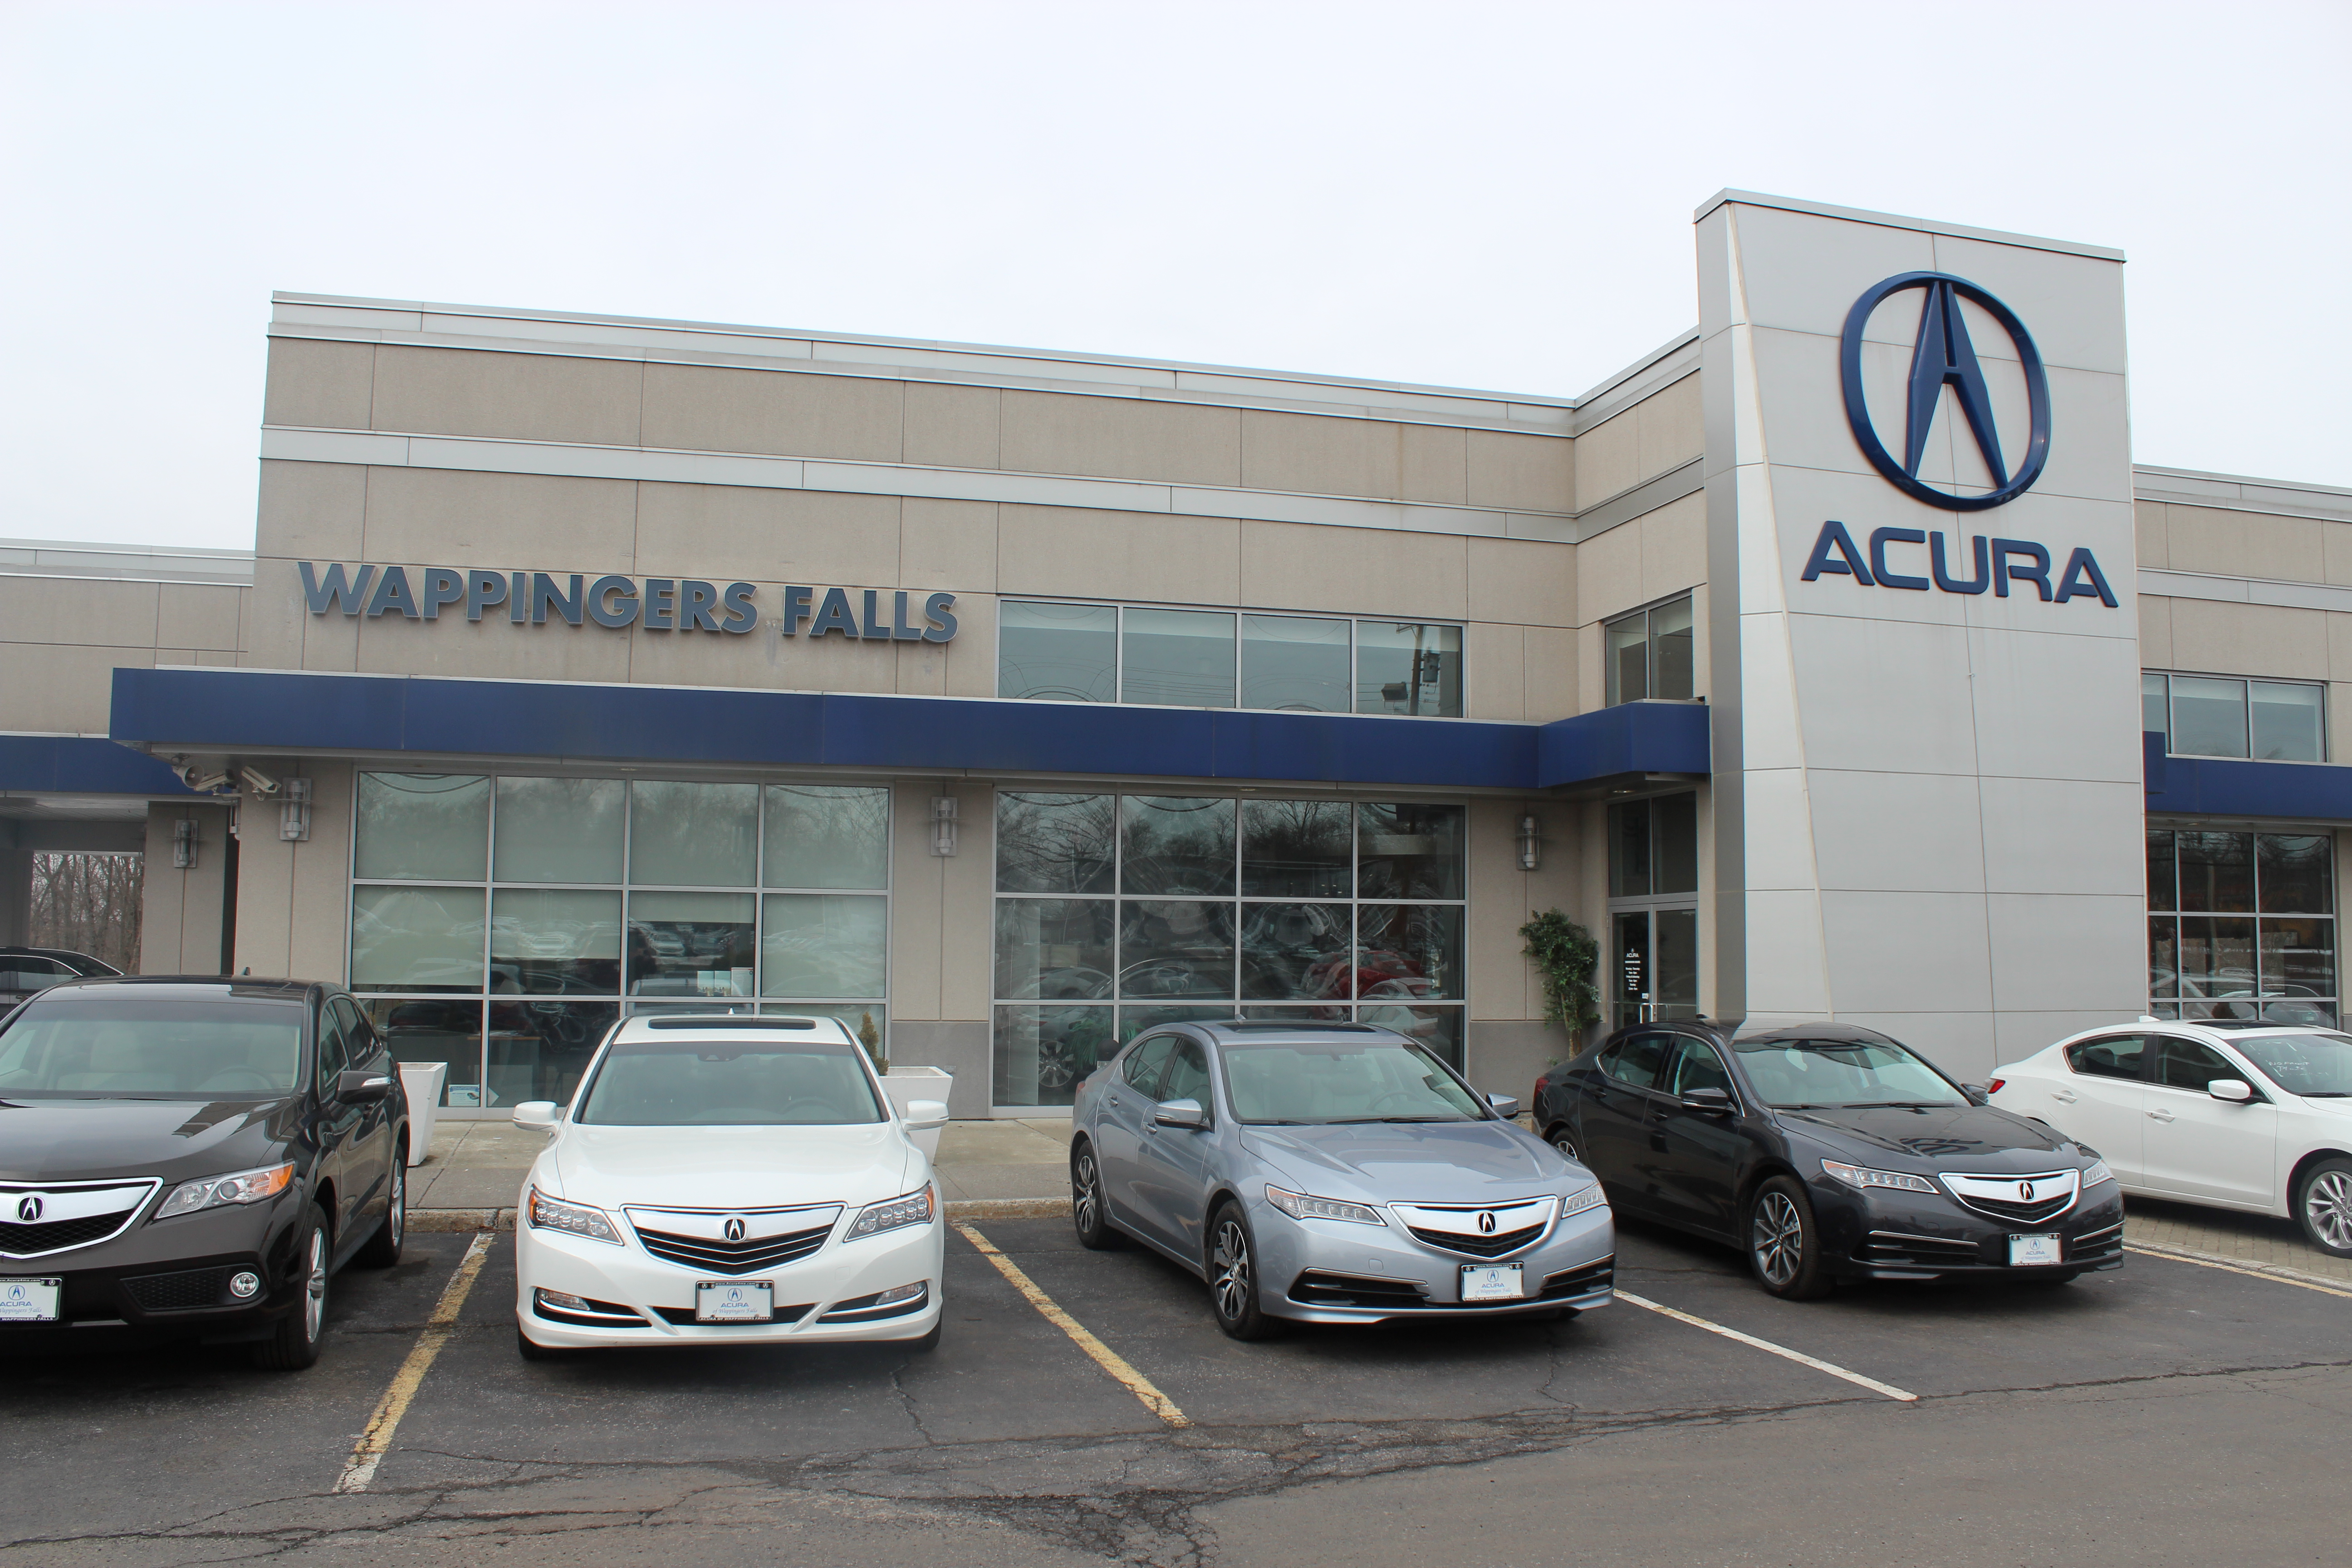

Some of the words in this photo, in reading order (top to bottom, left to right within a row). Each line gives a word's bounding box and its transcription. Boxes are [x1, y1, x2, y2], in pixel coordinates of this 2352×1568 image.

[298, 561, 759, 634] WAPPINGERS
[782, 585, 959, 643] FALLS
[1801, 520, 2119, 608] ACURA
